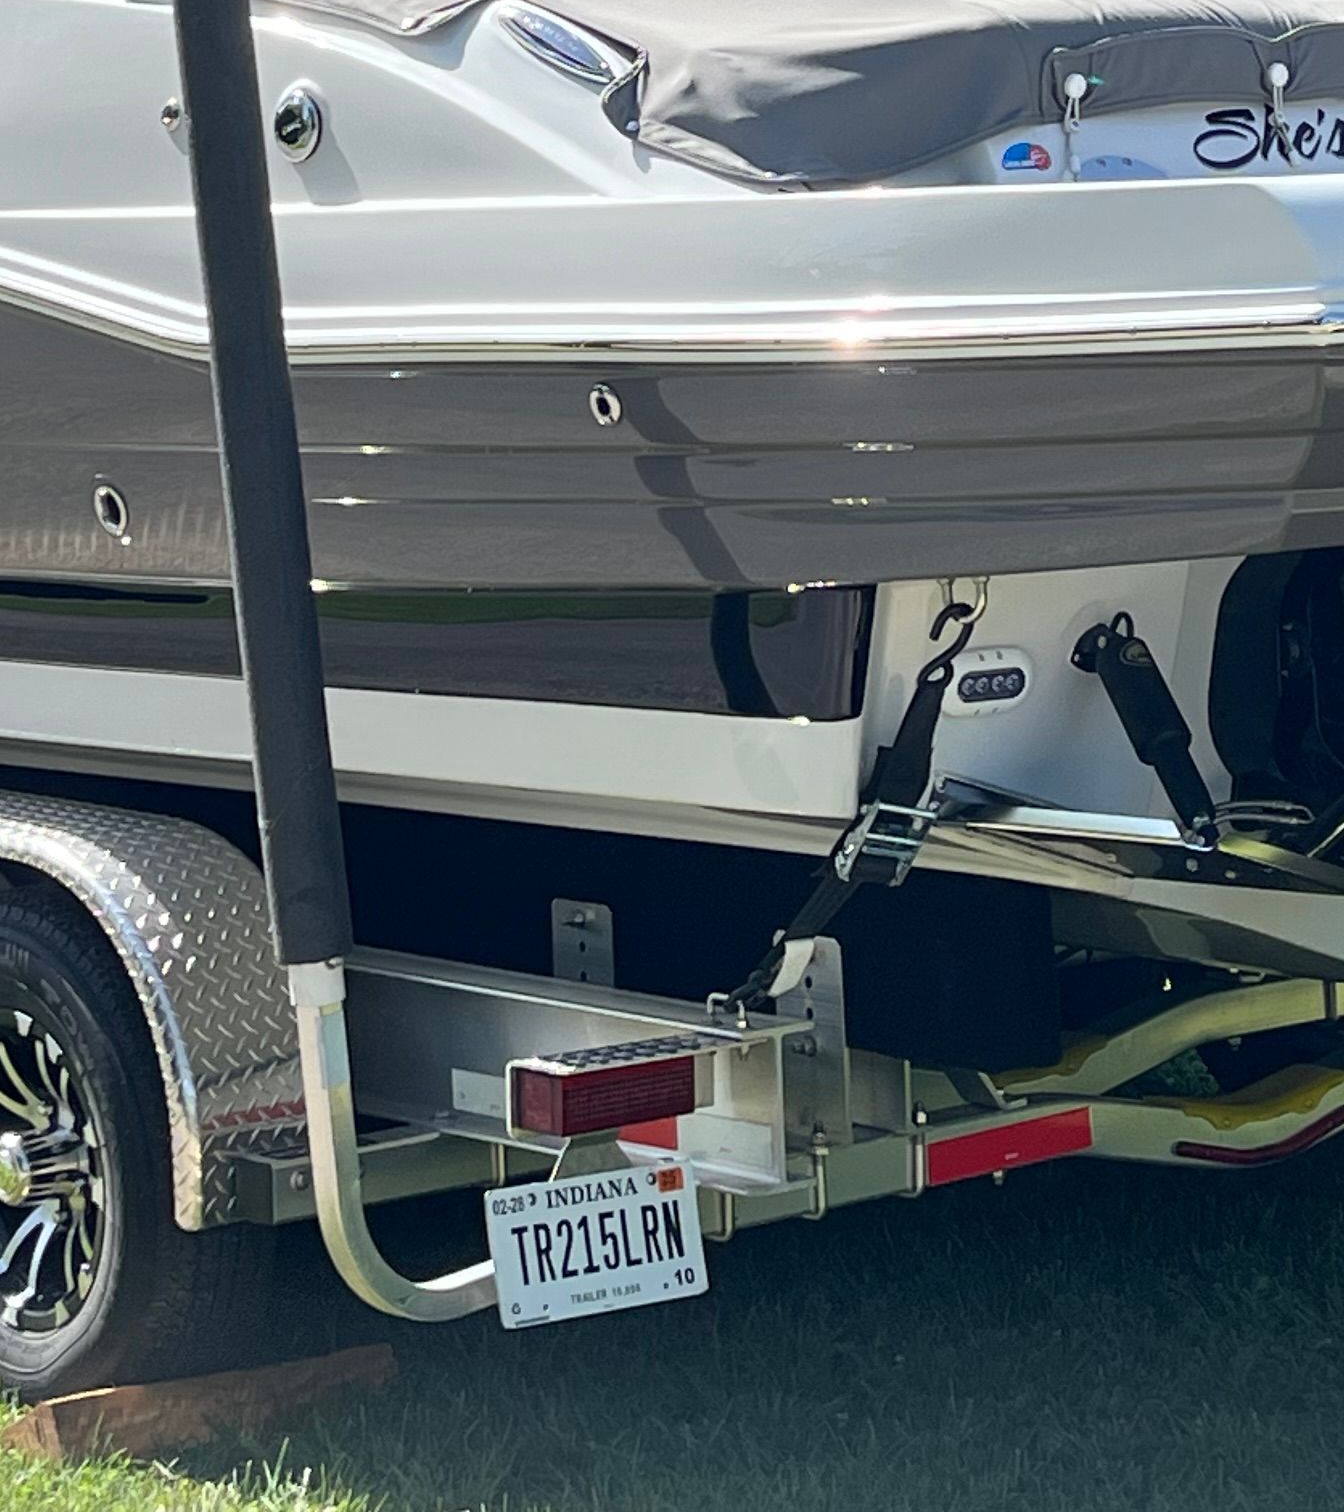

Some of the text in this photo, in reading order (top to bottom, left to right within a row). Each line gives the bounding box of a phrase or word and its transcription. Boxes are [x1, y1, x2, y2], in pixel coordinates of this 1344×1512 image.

[545, 1177, 638, 1209] INDIANA
[511, 1199, 685, 1286] TR215LRN
[674, 1267, 696, 1286] 10
